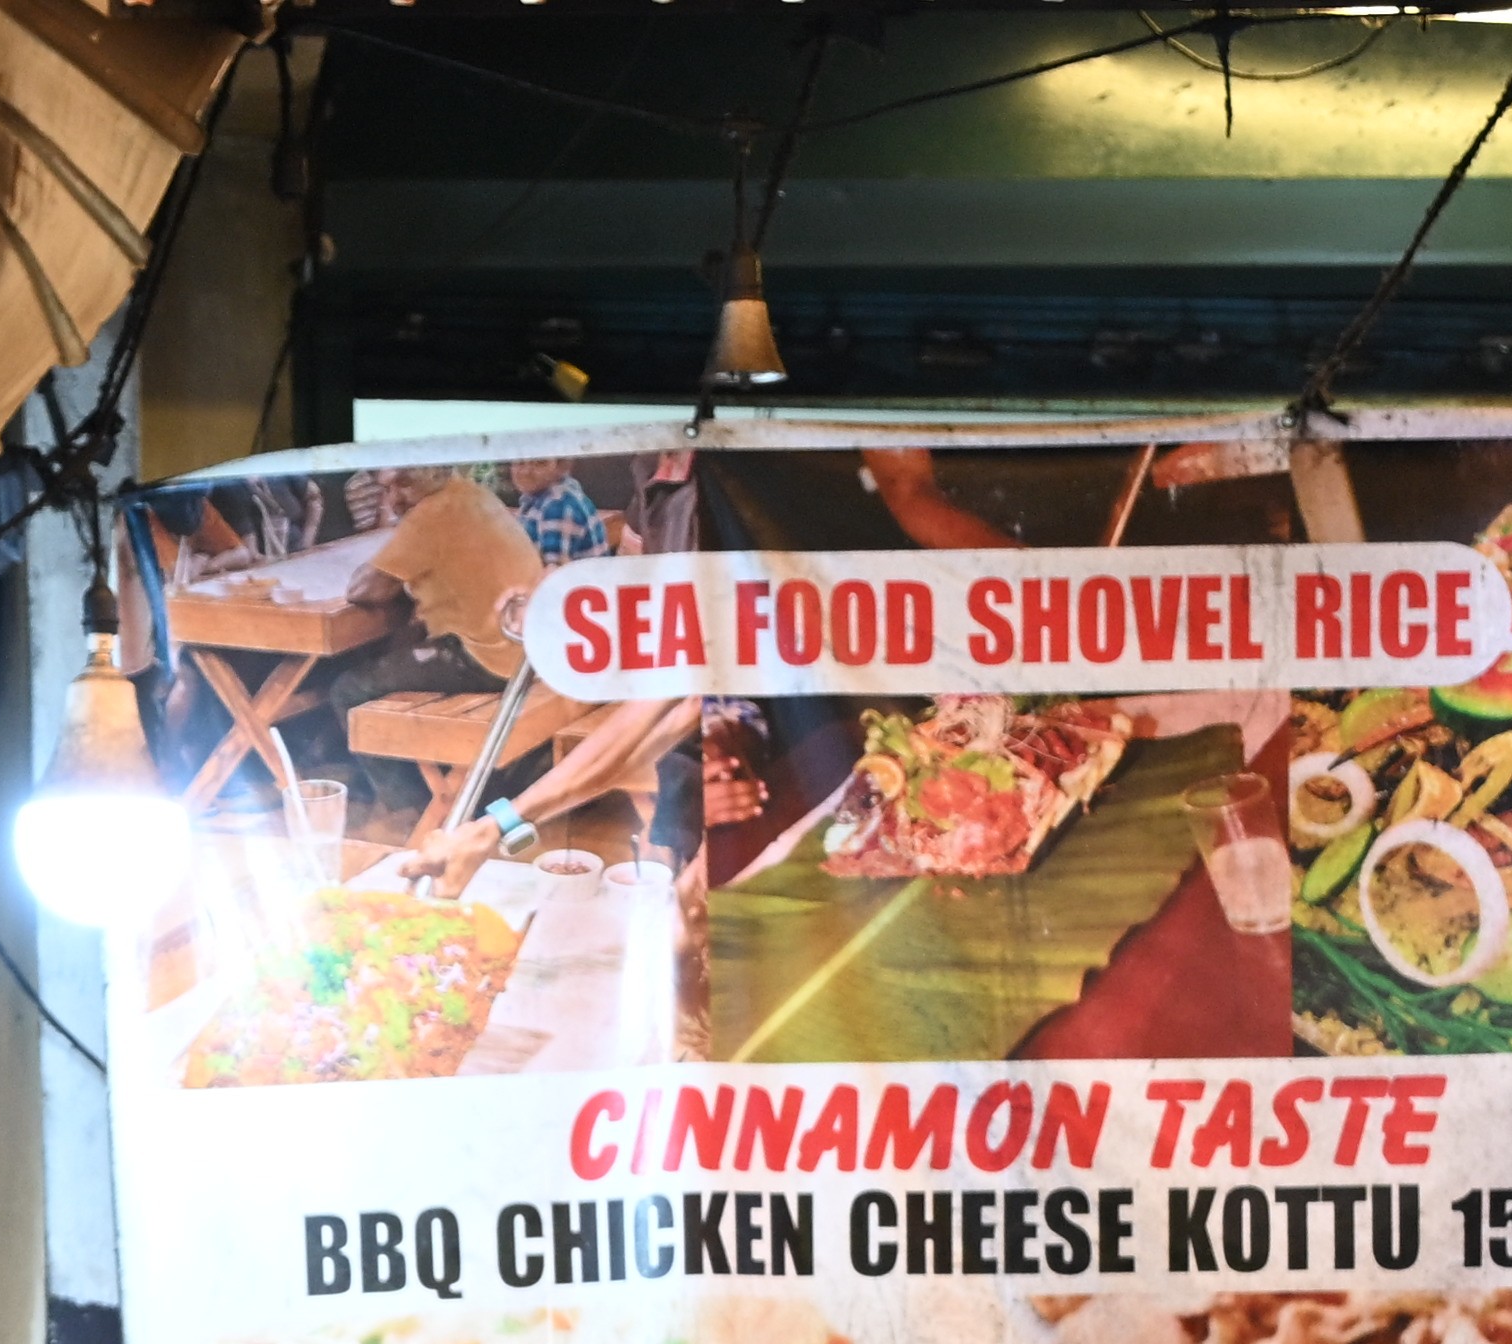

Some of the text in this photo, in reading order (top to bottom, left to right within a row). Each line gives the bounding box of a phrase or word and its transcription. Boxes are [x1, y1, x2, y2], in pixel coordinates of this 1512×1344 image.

[562, 569, 1473, 675] SEA FOOD SHOVEL RICE
[566, 1073, 1449, 1180] CINNAMON TASTE
[304, 1208, 462, 1300] BBQ
[496, 1190, 815, 1288] CHICKEN
[848, 1186, 1136, 1277] CHEESE
[1169, 1183, 1423, 1273] KOTTU
